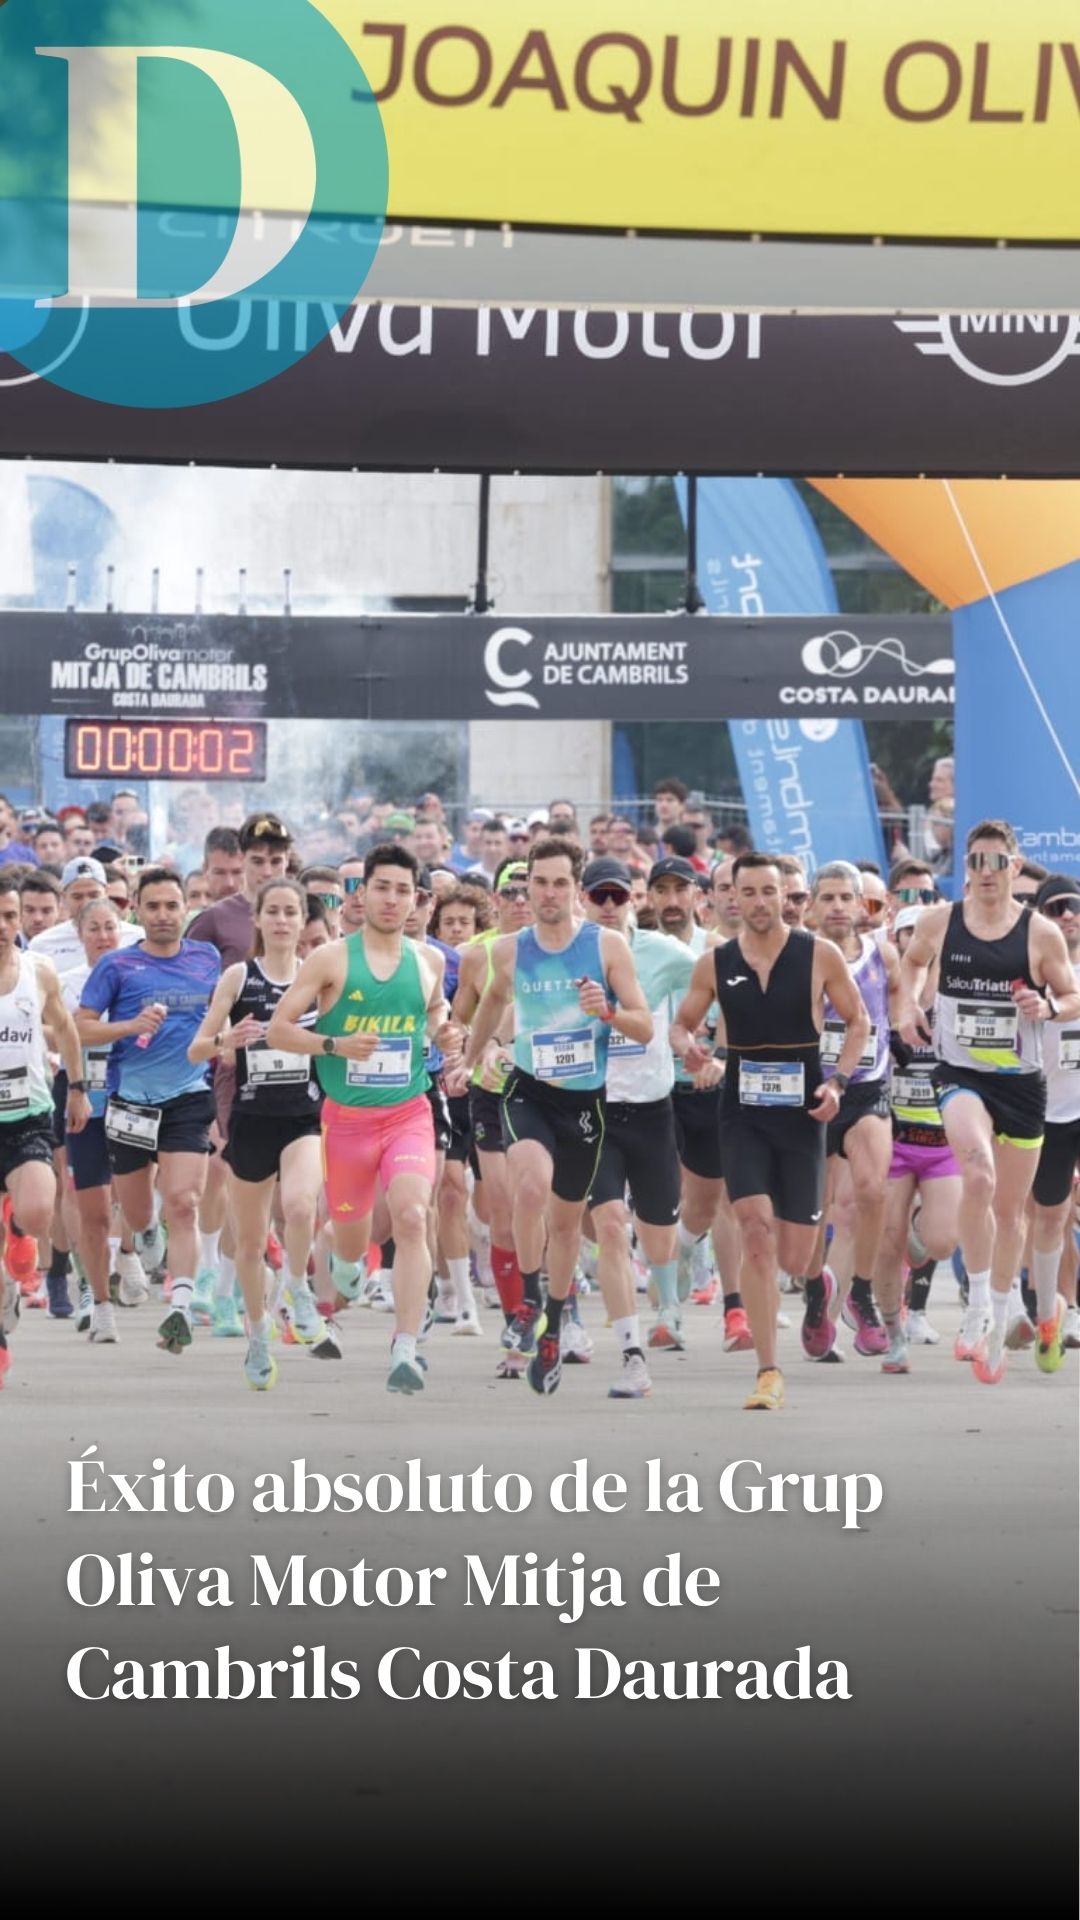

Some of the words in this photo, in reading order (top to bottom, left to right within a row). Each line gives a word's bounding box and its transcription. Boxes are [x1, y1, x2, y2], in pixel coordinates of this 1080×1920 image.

[351, 22, 846, 123] JOAQUIN
[543, 641, 689, 662] AJUNTAMENT
[51, 660, 120, 689] MITJA
[125, 662, 153, 690] DE
[157, 663, 268, 691] CAMBRILS
[543, 664, 574, 685] DE
[577, 664, 689, 685] CAMBRILS
[112, 691, 149, 707] COSTA
[779, 686, 859, 704] COSTA
[77, 726, 254, 773] 00:00:02
[522, 978, 577, 993] QUETZ
[555, 1054, 576, 1065] 1201
